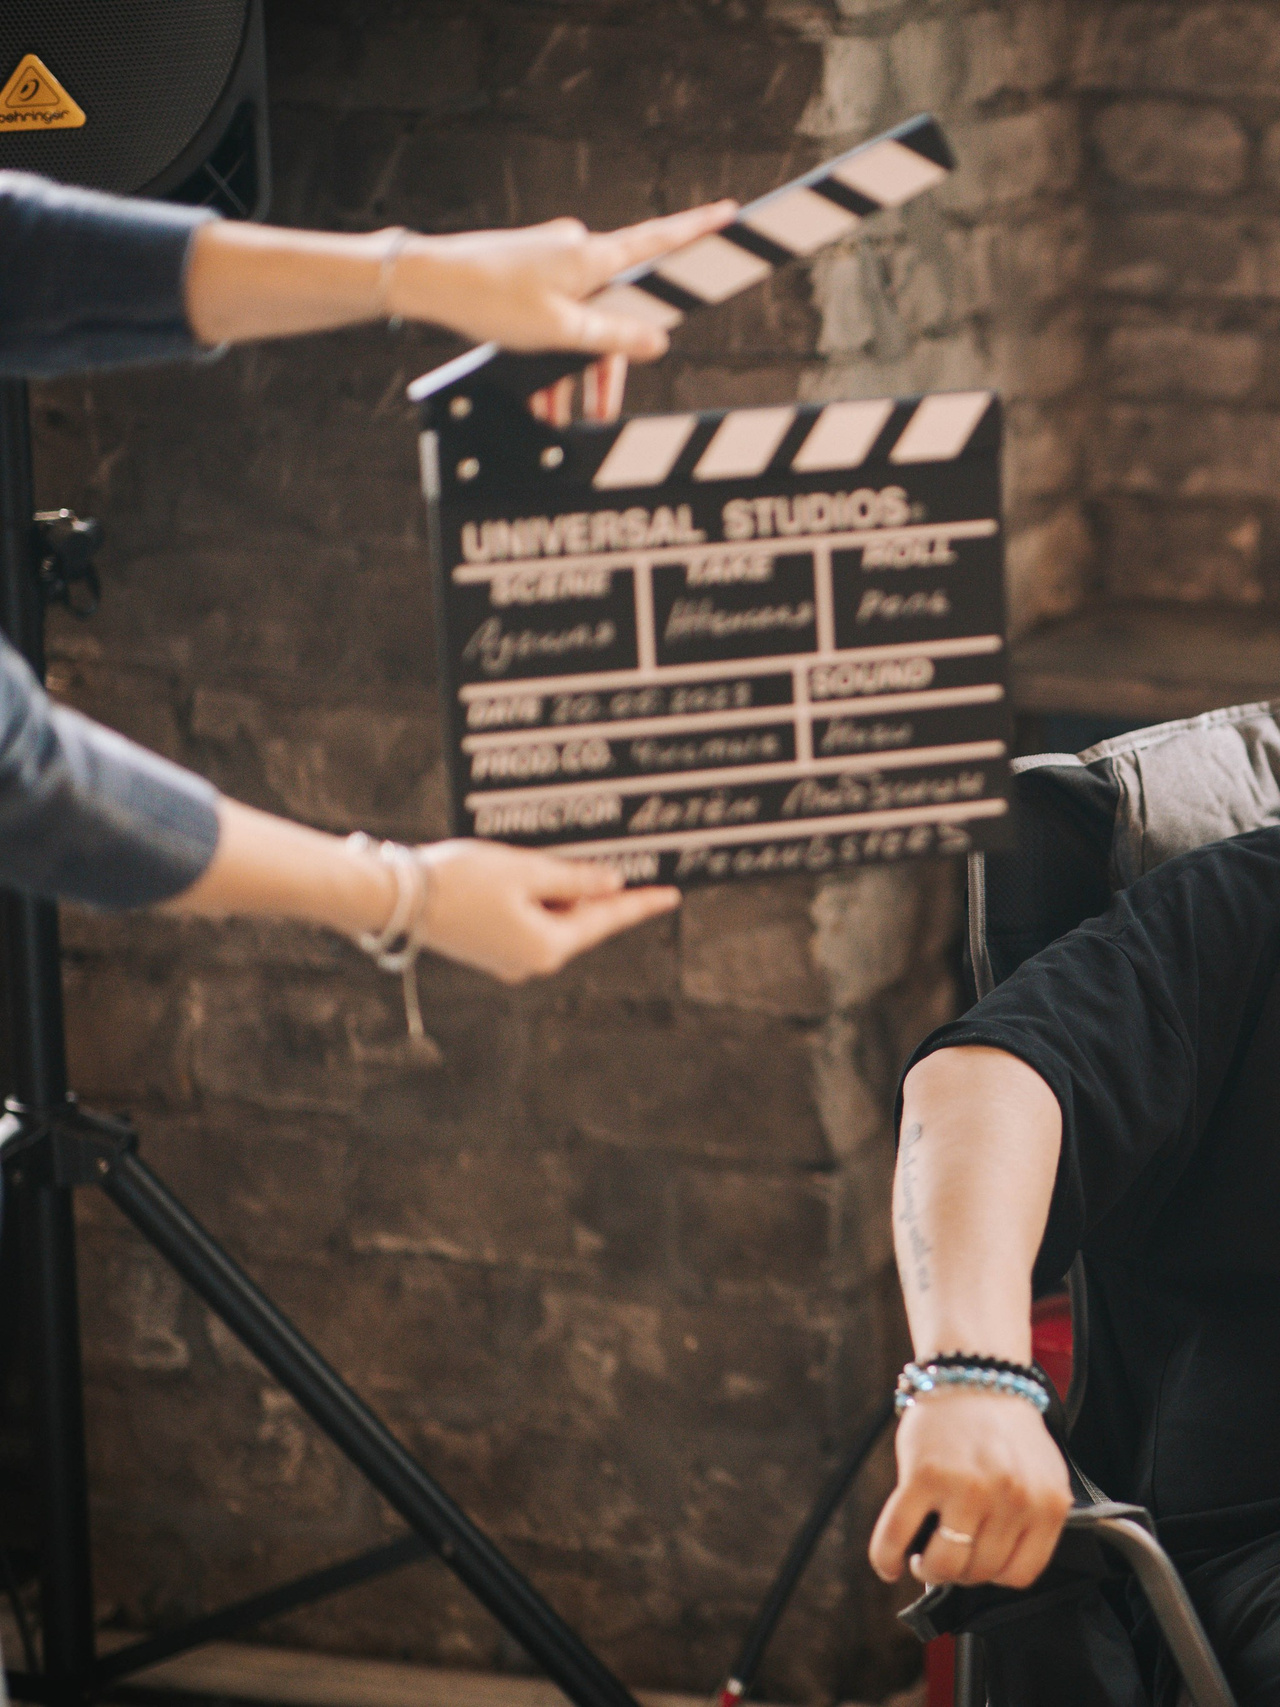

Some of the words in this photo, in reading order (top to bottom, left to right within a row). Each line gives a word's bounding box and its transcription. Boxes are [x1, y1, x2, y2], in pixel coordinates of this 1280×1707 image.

[462, 503, 707, 562] UNIVERSAL
[722, 486, 911, 540] STUDIOS
[861, 535, 957, 571] ROLL
[810, 658, 935, 698] SOUND
[474, 796, 622, 836] DIRECTOR
